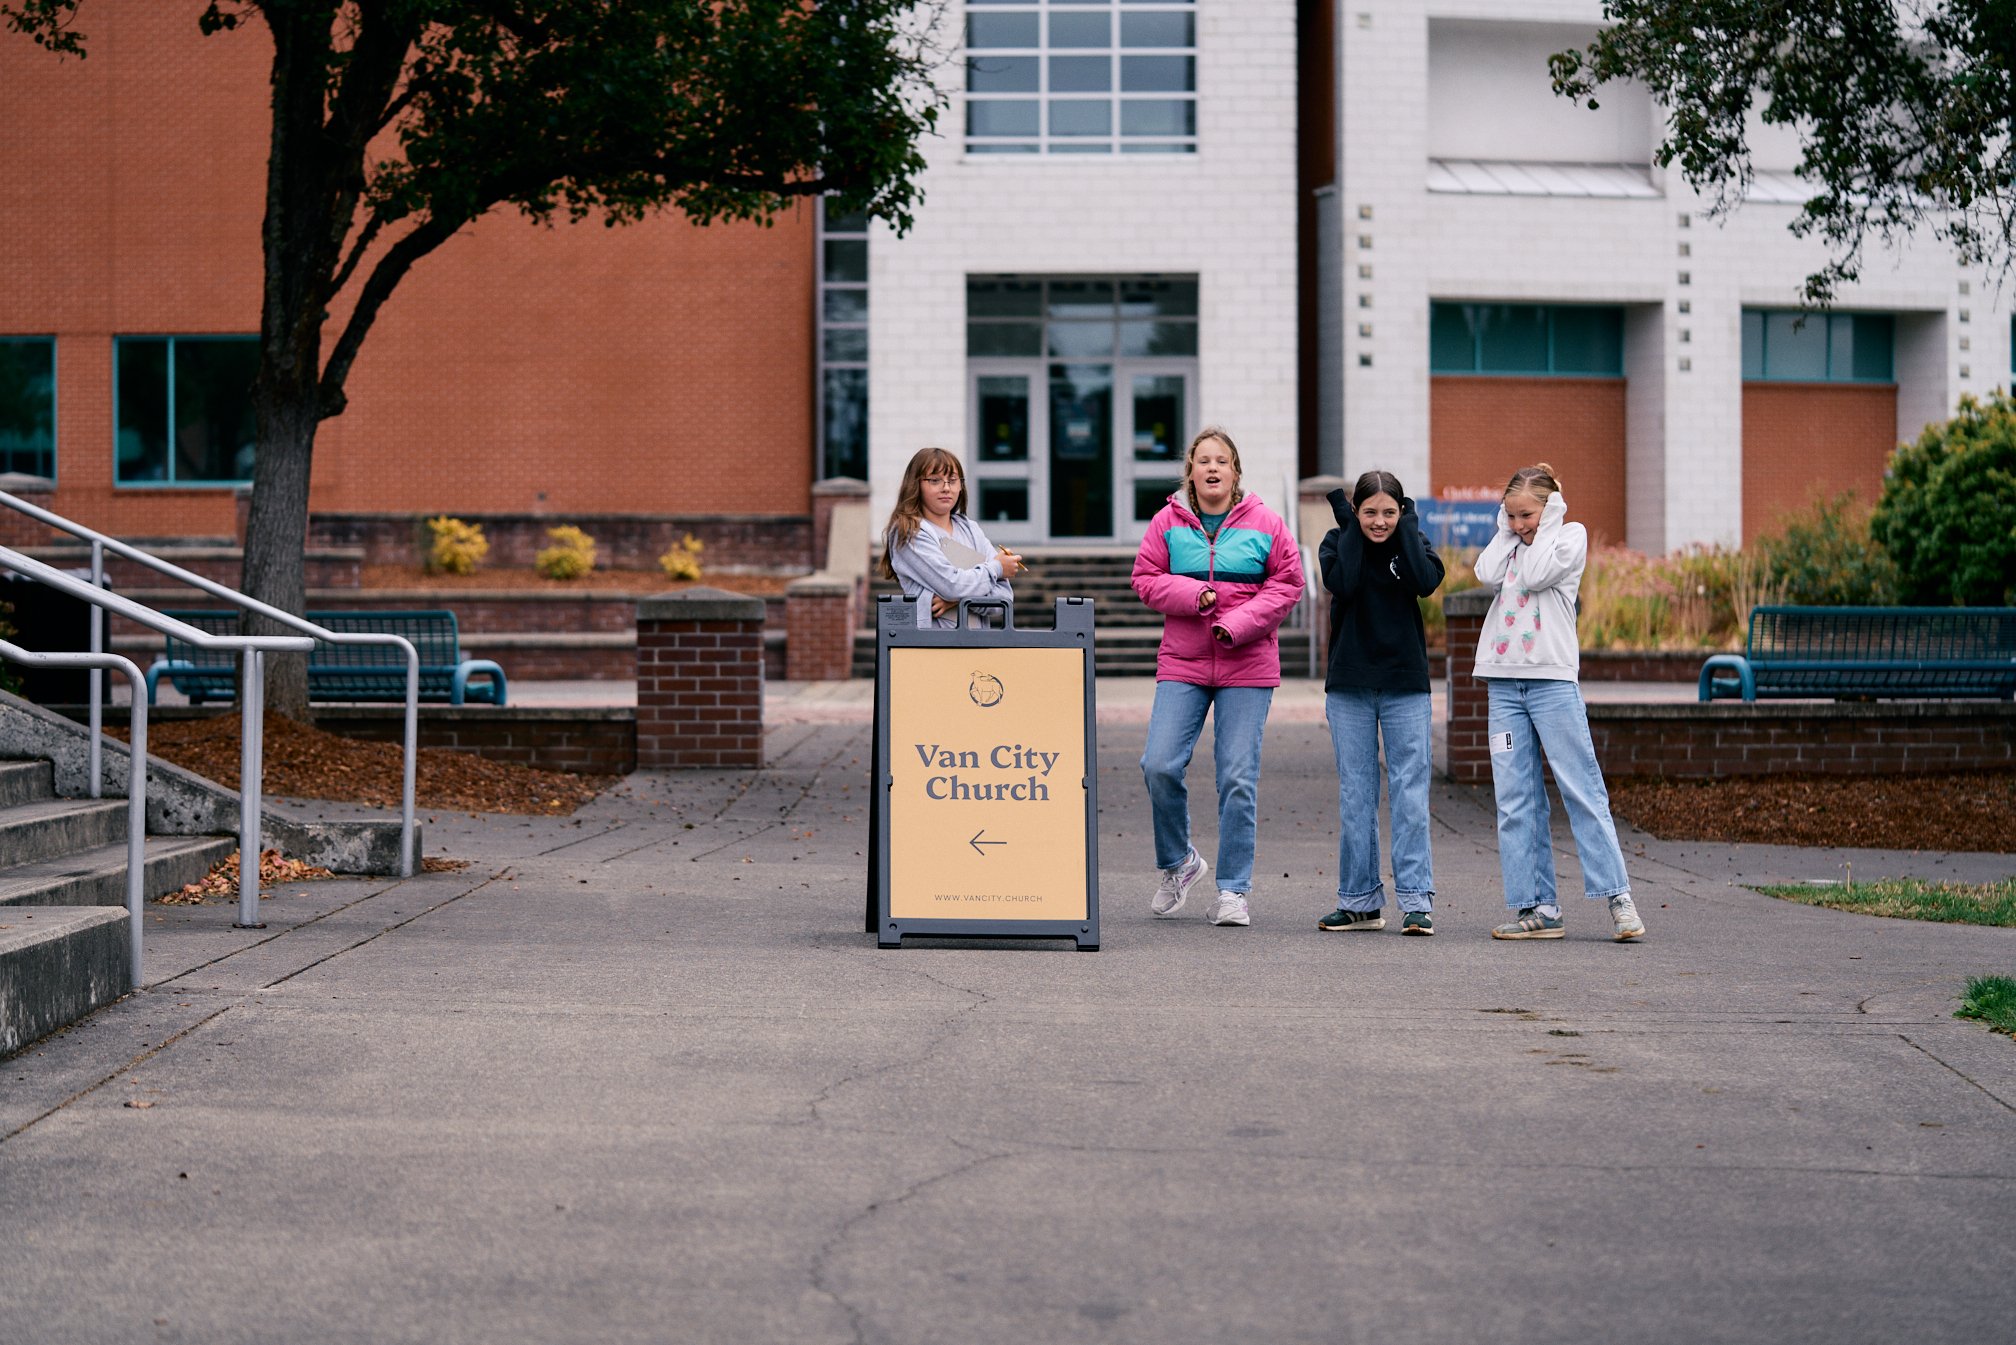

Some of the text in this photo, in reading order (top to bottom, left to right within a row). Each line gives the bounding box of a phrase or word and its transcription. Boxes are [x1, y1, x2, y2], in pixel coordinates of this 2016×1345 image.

[914, 744, 1060, 777] Van City
[926, 775, 1050, 801] Church
[934, 894, 1043, 902] WWW.VANCITY.CHURCH
